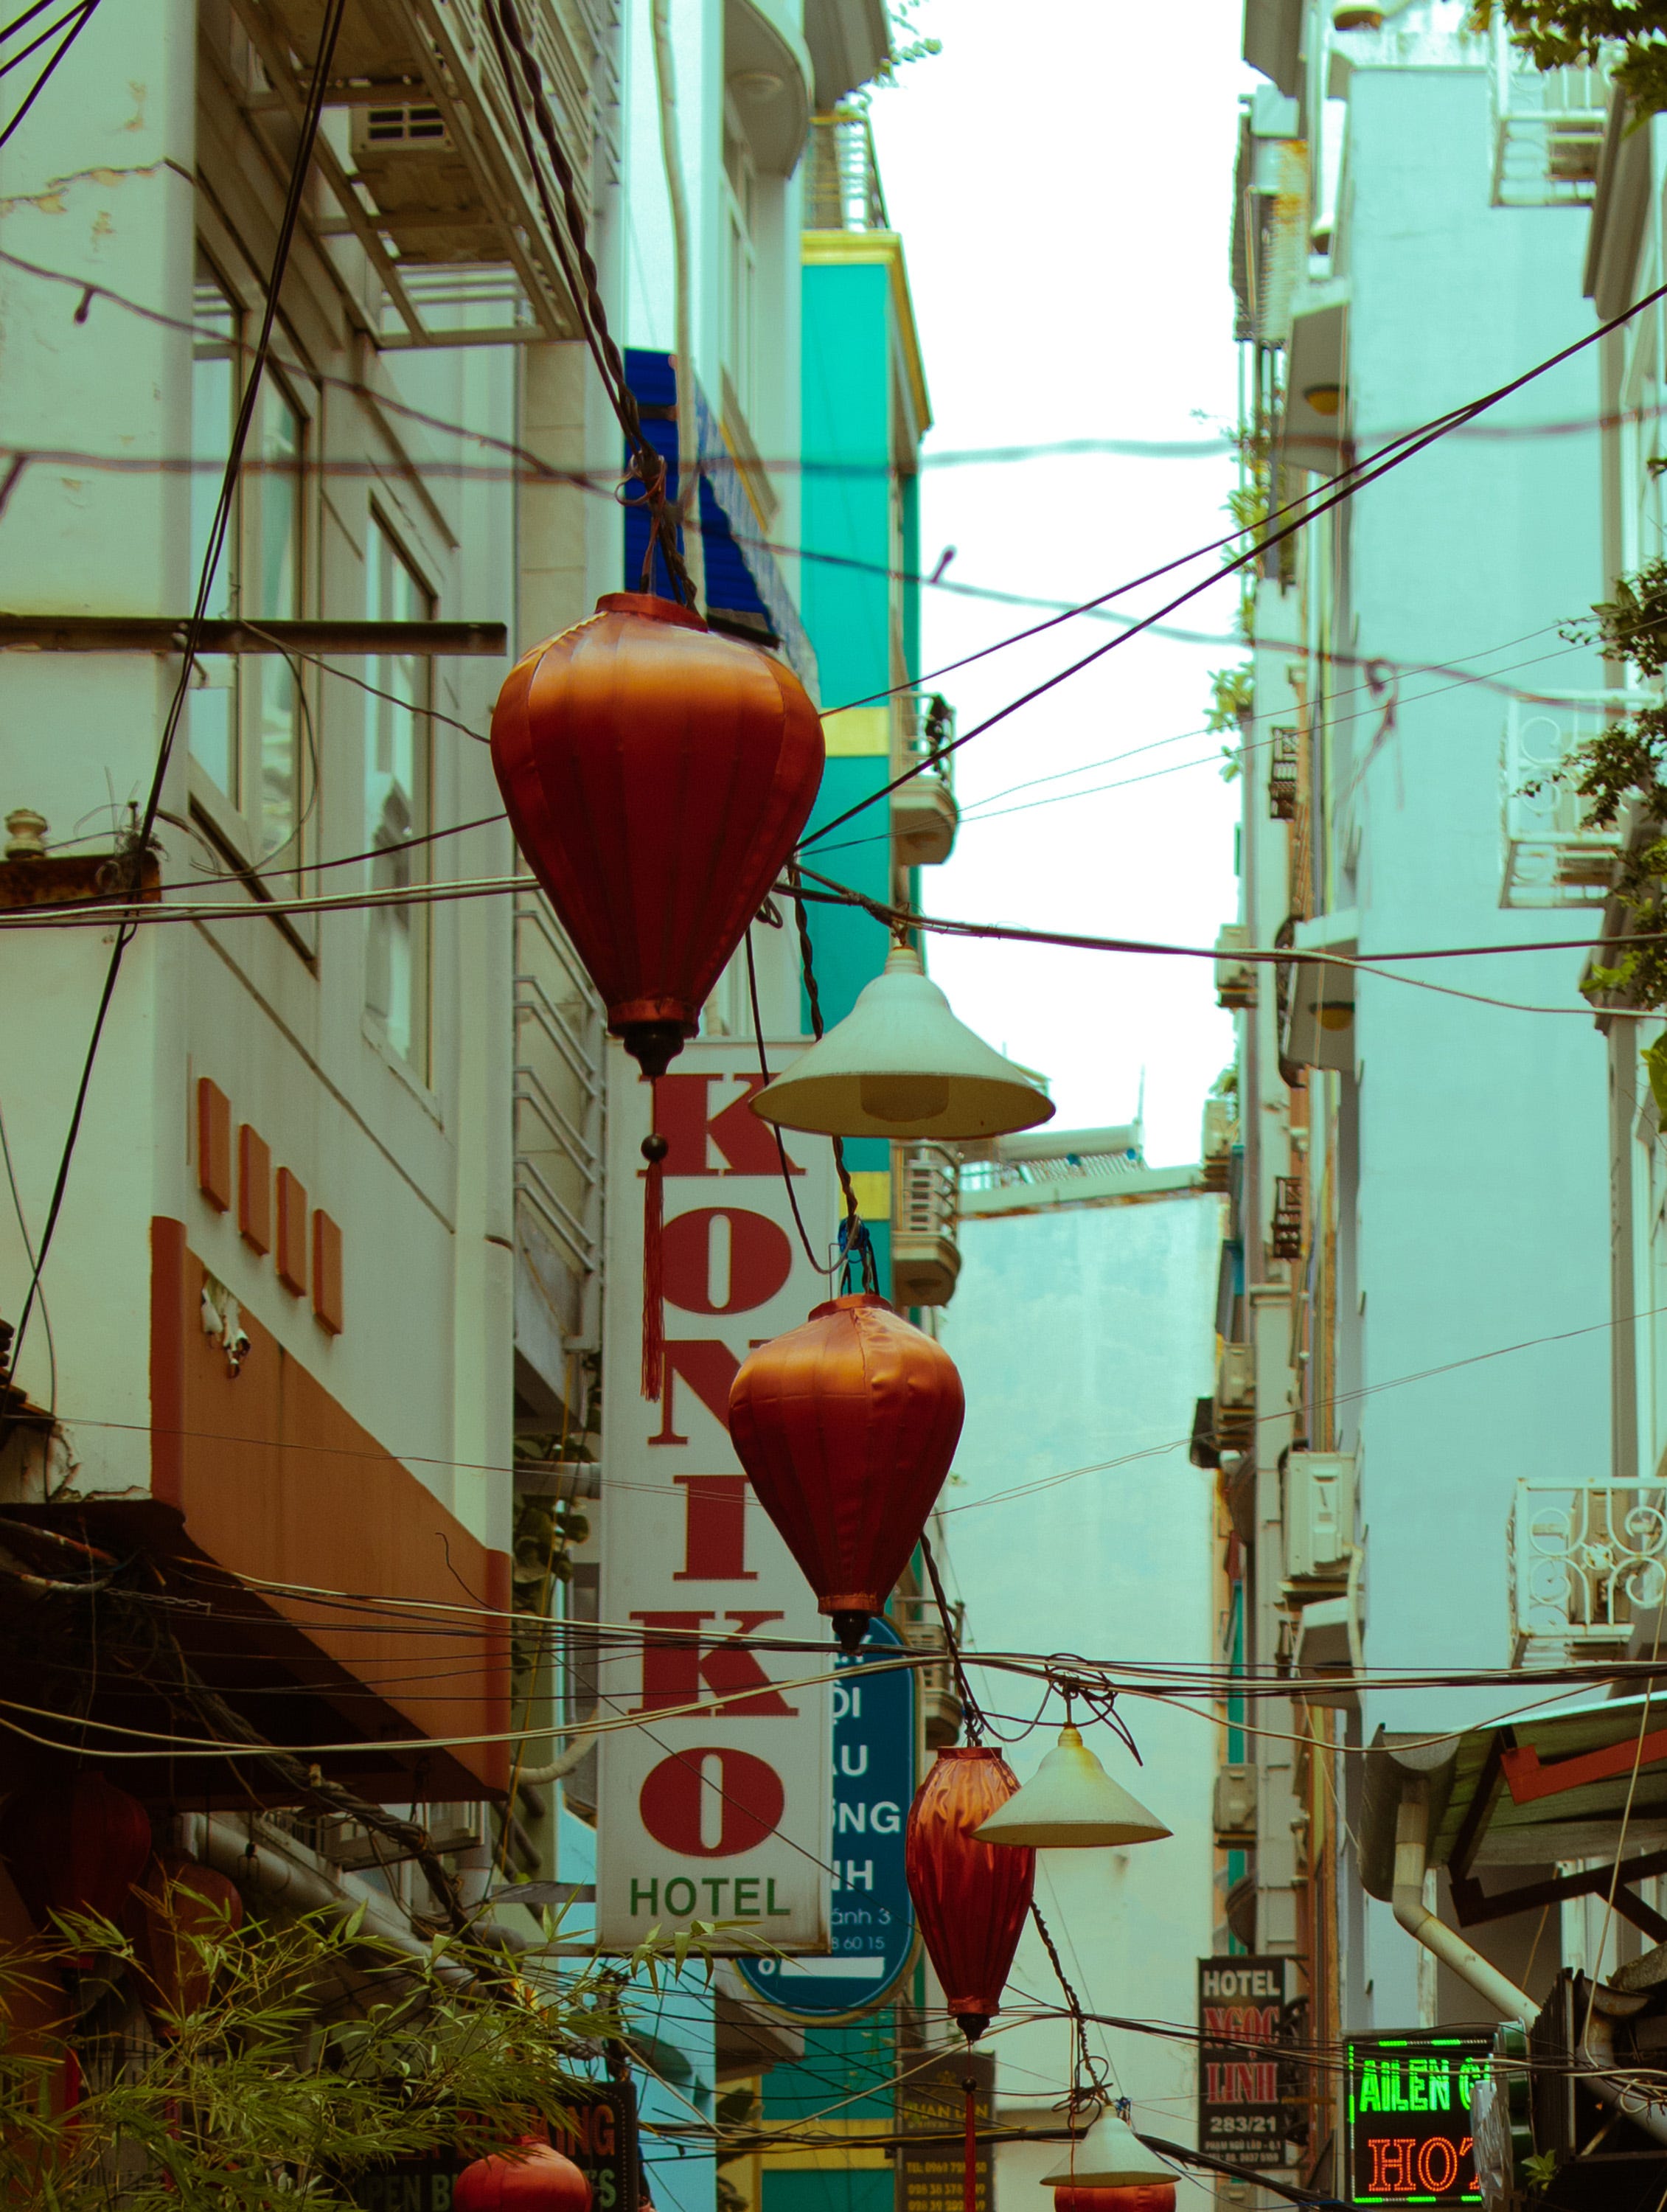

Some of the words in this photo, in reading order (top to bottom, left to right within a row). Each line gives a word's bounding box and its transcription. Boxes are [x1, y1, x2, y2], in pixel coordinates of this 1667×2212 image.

[833, 1798, 900, 1834] NG
[630, 1878, 791, 1916] HOTEL
[878, 1907, 891, 1925] 3
[843, 1936, 863, 1950] 60
[869, 1936, 885, 1950] 15
[1203, 1969, 1281, 1997] HOTEL
[1203, 2006, 1281, 2059] NGỌC
[1205, 2062, 1278, 2104] LINH
[1359, 2059, 1451, 2112] AILEN
[955, 2104, 988, 2119] LN
[1209, 2115, 1277, 2133] 283/21
